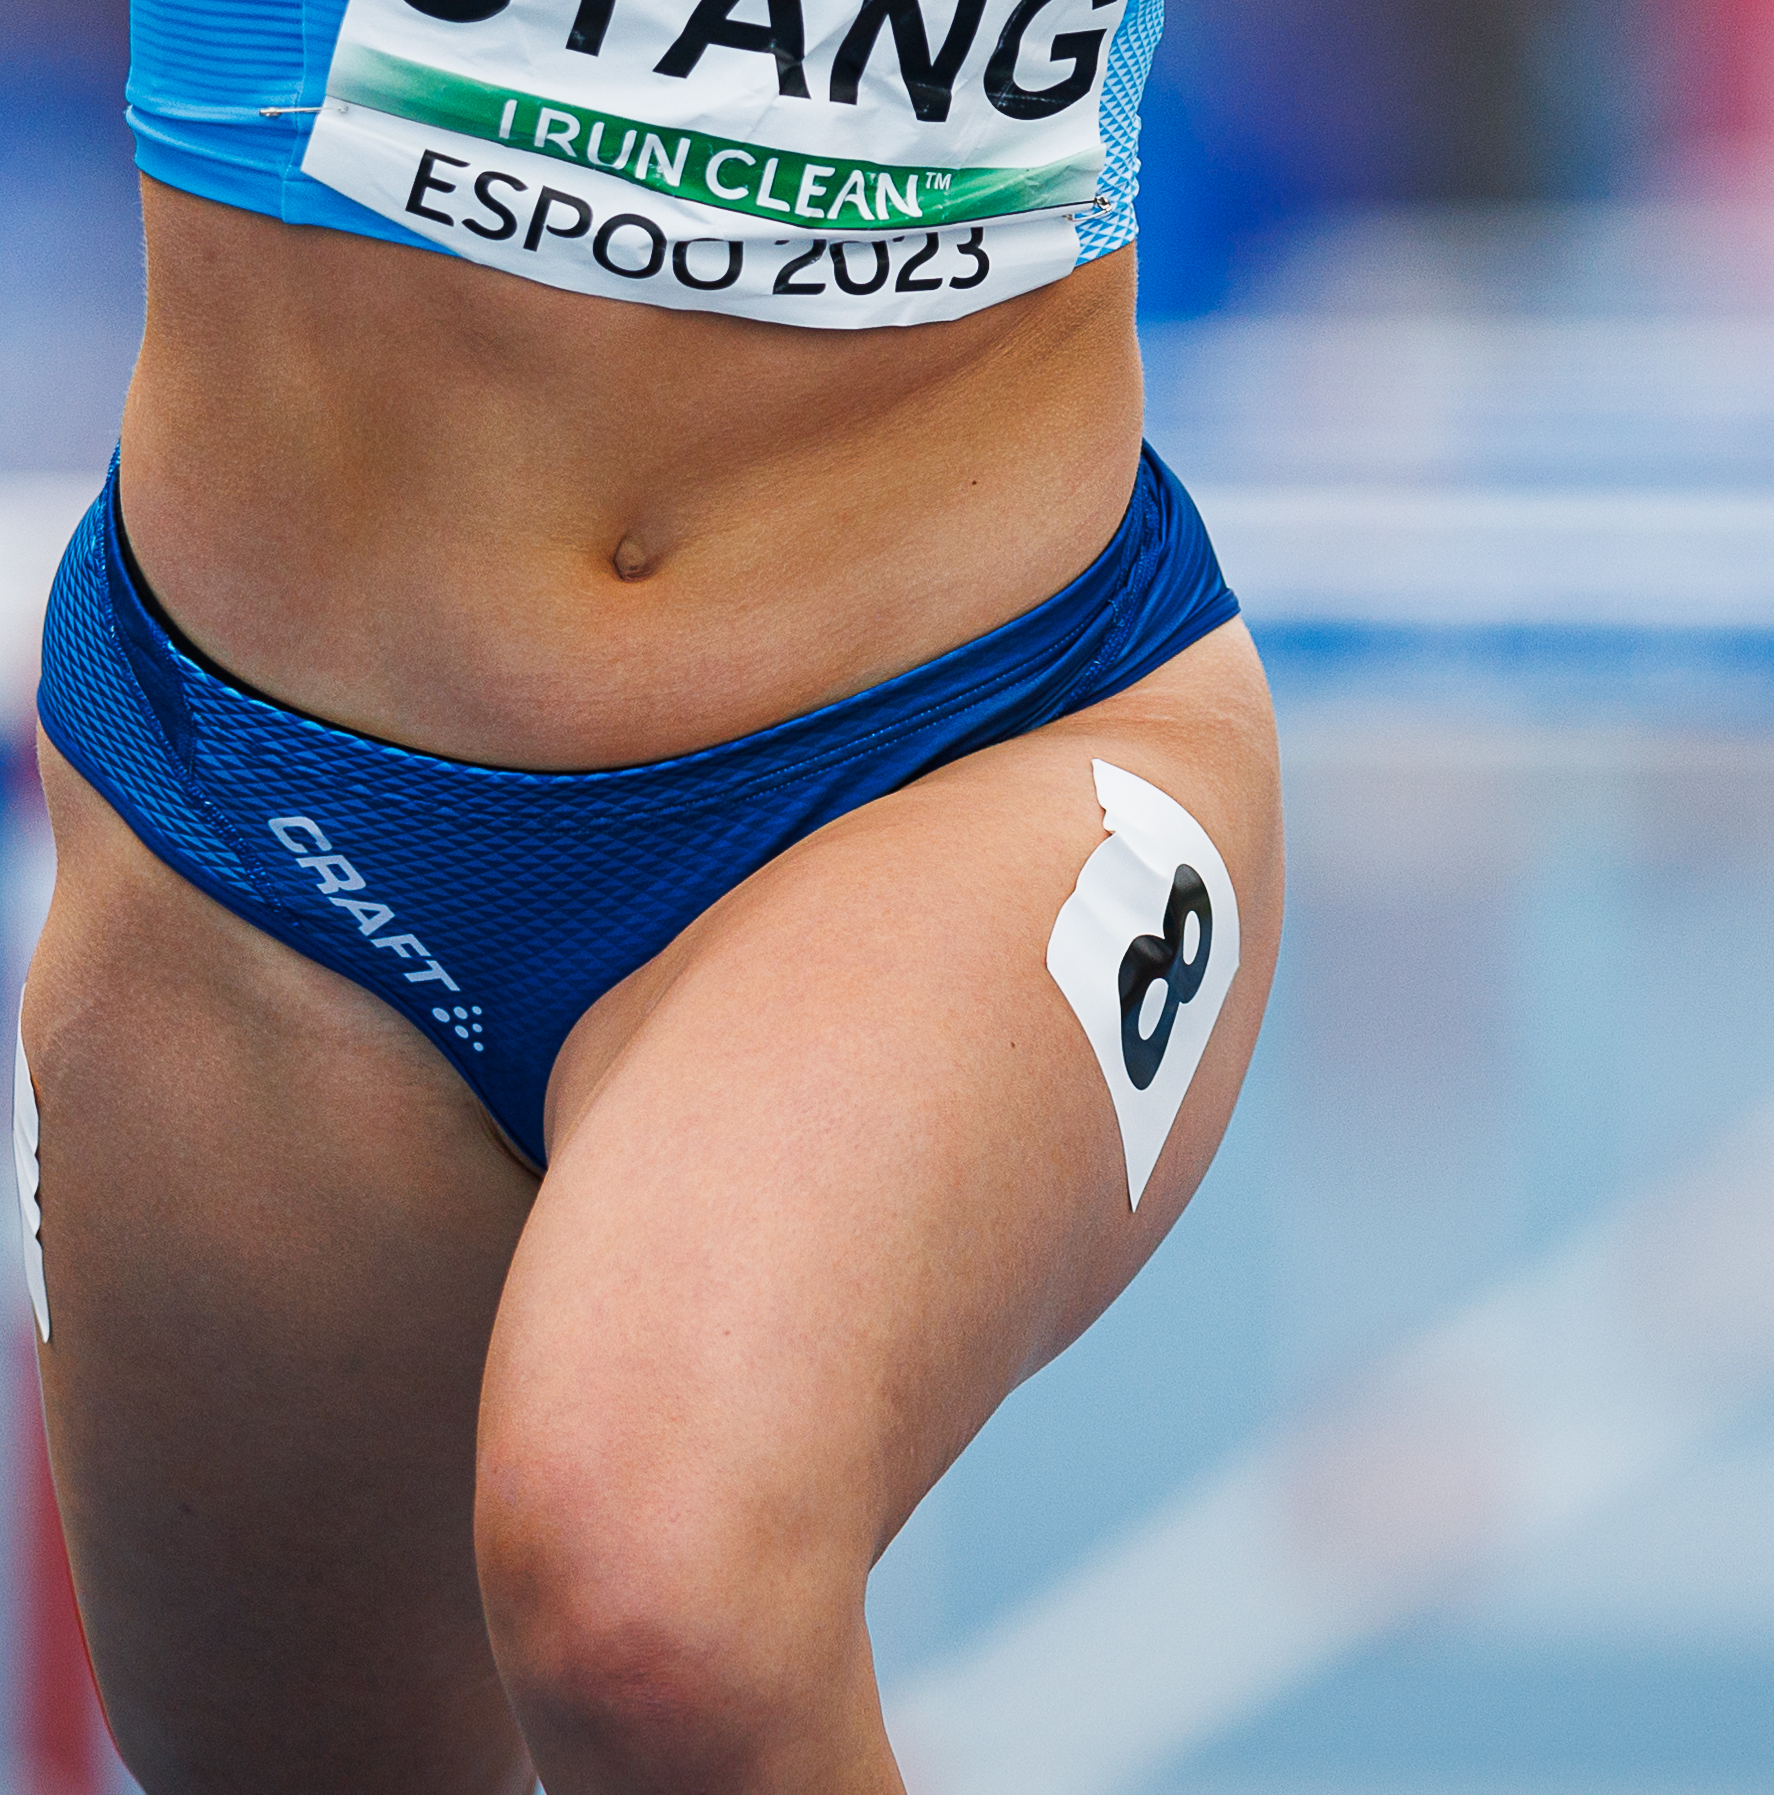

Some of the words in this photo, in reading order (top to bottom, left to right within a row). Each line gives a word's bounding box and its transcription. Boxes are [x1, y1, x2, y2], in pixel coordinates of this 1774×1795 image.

[405, 149, 743, 290] ESPOO
[772, 227, 991, 295] 2023
[499, 99, 518, 139] I
[534, 110, 689, 186] RUN
[269, 816, 460, 992] CRAFT
[1118, 863, 1213, 1090] 8
